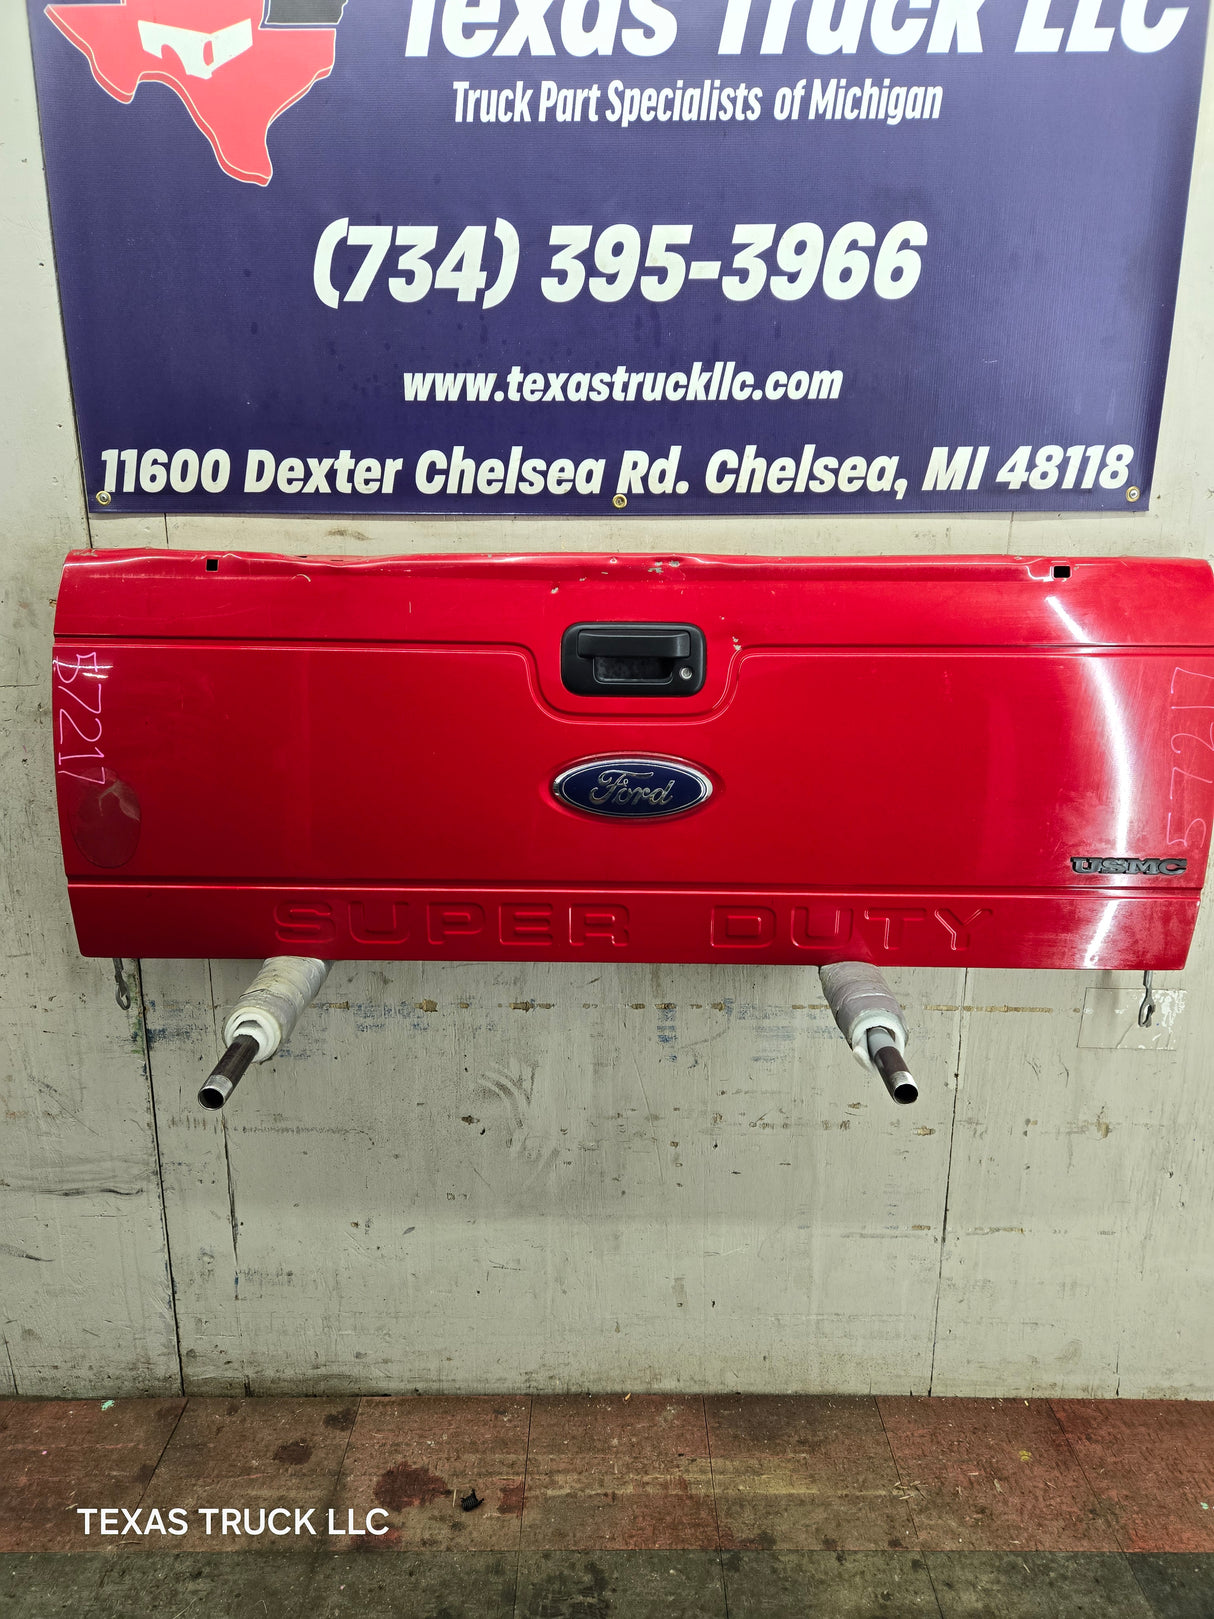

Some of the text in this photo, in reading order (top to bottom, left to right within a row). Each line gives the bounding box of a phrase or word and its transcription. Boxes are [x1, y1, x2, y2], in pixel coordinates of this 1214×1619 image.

[1014, 0, 1189, 54] LLC
[452, 78, 944, 128] Truck Part Specialists of Michigan
[313, 217, 928, 310] (734) 395-3966
[403, 361, 844, 402] www.texastruckllc.com
[100, 443, 1135, 500] 11600 Dexter Chelsea Rd. Chelsea, MI 48118
[589, 769, 676, 806] Ford
[1070, 856, 1188, 876] USMC
[273, 901, 994, 951] SUPER DUTY
